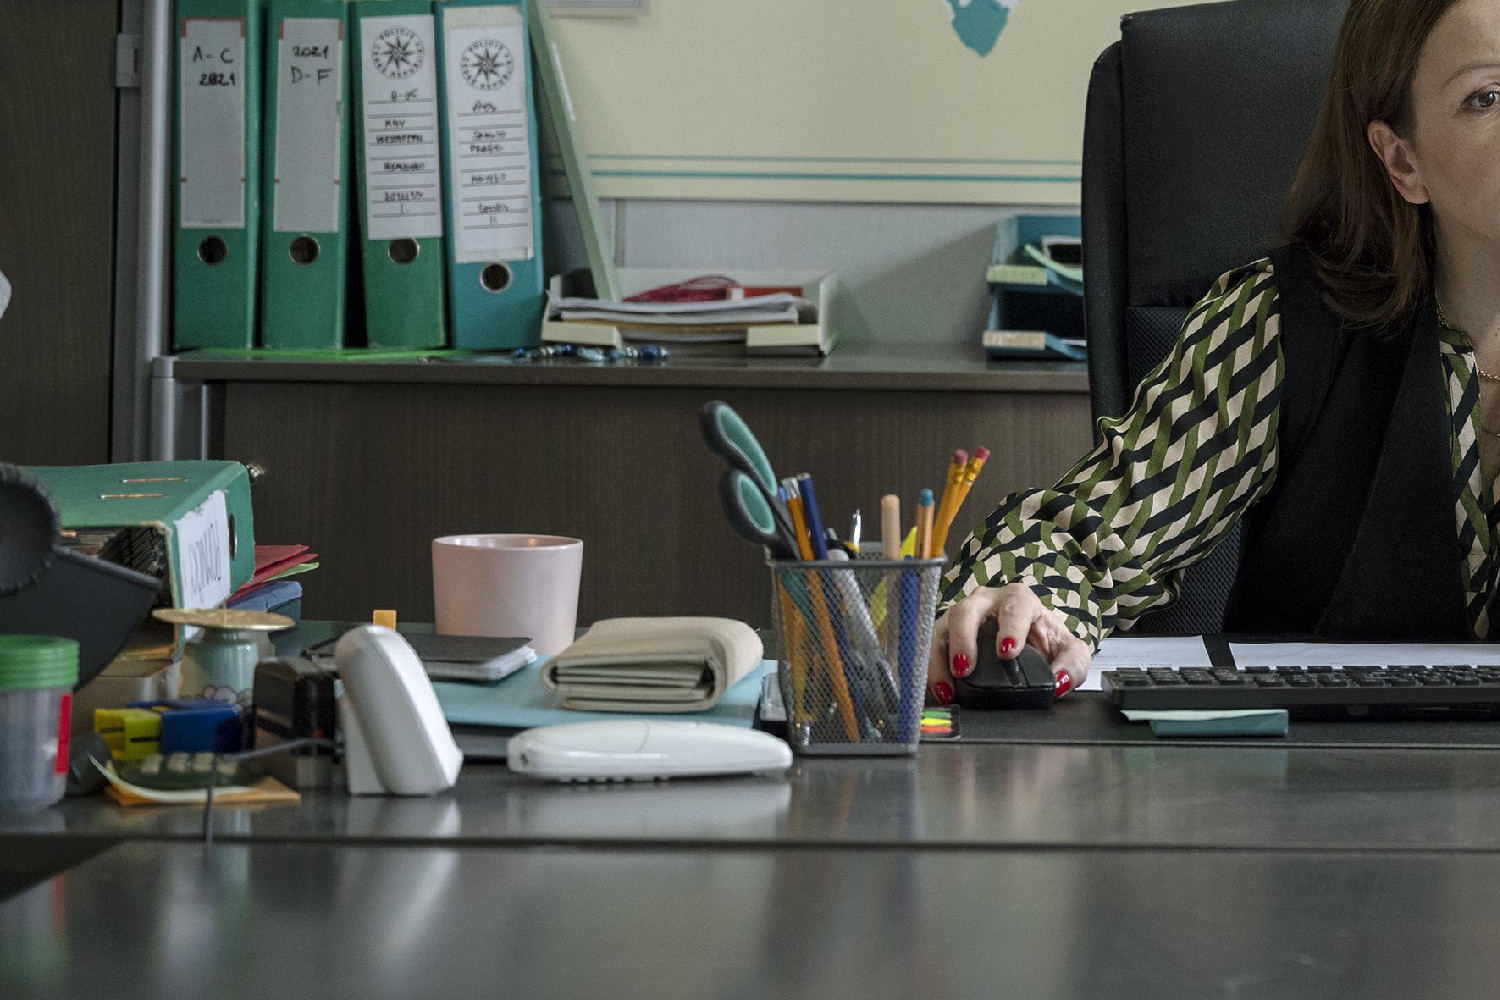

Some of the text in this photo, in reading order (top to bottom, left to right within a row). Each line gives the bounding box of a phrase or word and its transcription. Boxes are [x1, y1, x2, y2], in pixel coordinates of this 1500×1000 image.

[192, 44, 203, 63] A
[220, 48, 235, 64] C
[292, 45, 329, 60] 2021
[199, 71, 236, 87] 2021
[317, 67, 334, 86] F
